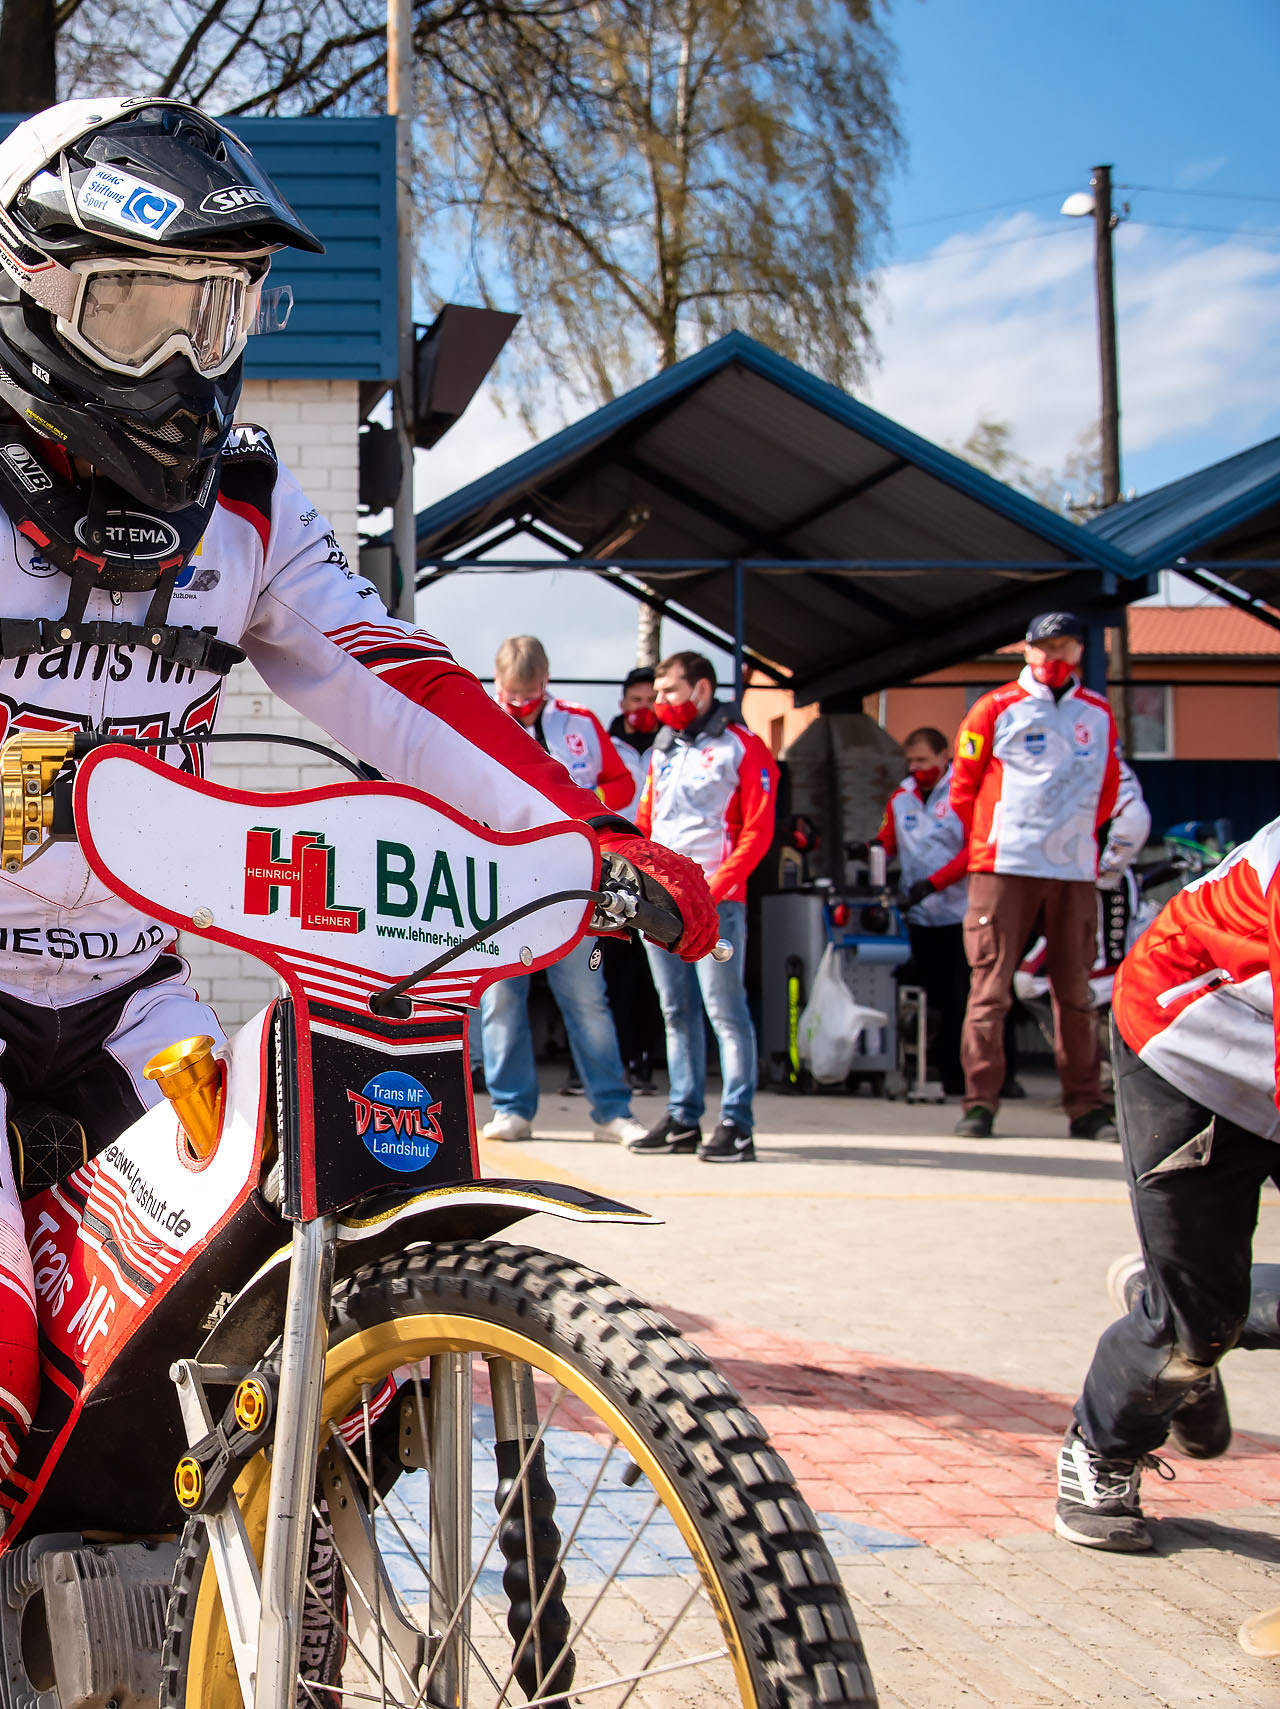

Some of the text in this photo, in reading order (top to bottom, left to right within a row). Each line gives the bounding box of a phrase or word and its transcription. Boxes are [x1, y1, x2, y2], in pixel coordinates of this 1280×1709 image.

[88, 181, 126, 203] Stiftung
[83, 193, 109, 211] Sport
[33, 364, 48, 382] TK
[6, 444, 53, 489] ONB
[247, 867, 300, 881] HEINRICH
[376, 840, 499, 933] BAU
[307, 914, 351, 927] LEHNER
[372, 1085, 424, 1103] Trans MF
[346, 1089, 444, 1144] DEVILS
[373, 1139, 431, 1157] Landshut
